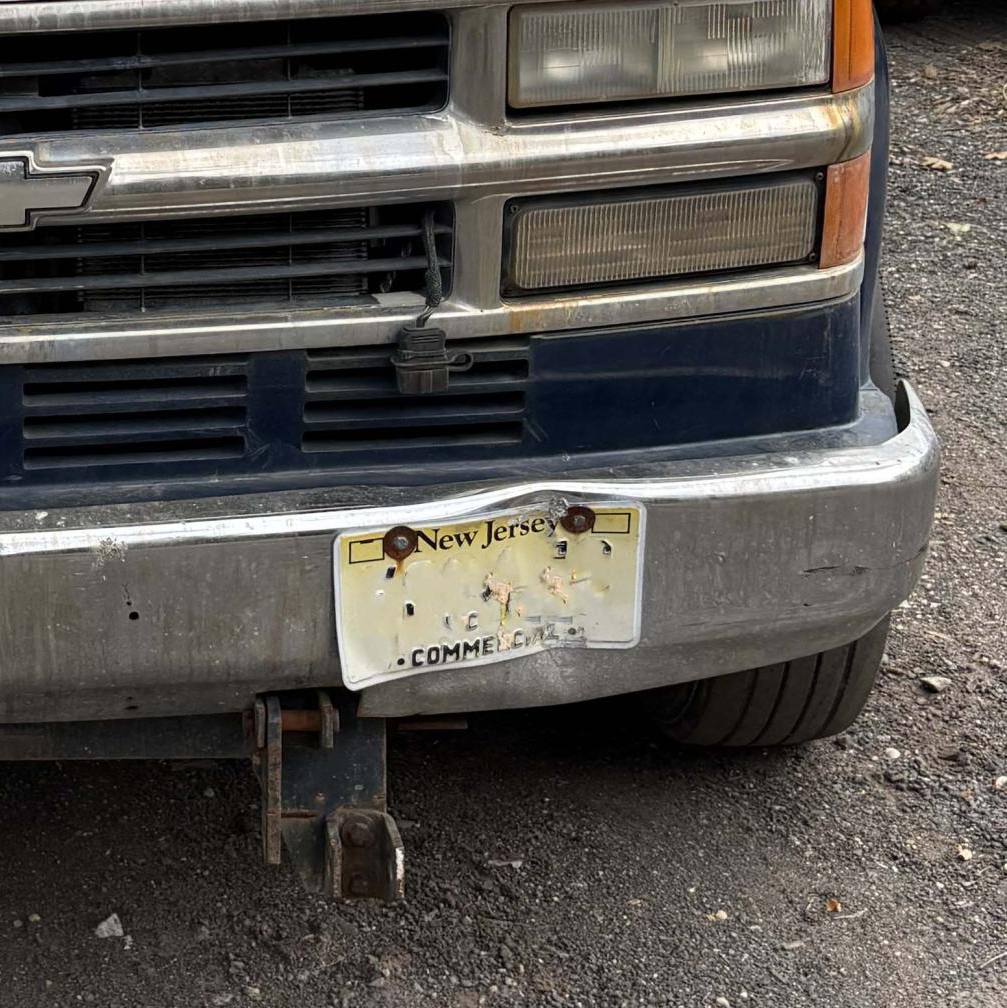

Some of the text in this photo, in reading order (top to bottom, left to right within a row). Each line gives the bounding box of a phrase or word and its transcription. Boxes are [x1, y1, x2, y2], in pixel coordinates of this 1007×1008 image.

[414, 515, 560, 553] New Jersey
[411, 622, 560, 667] COMMECIAL
